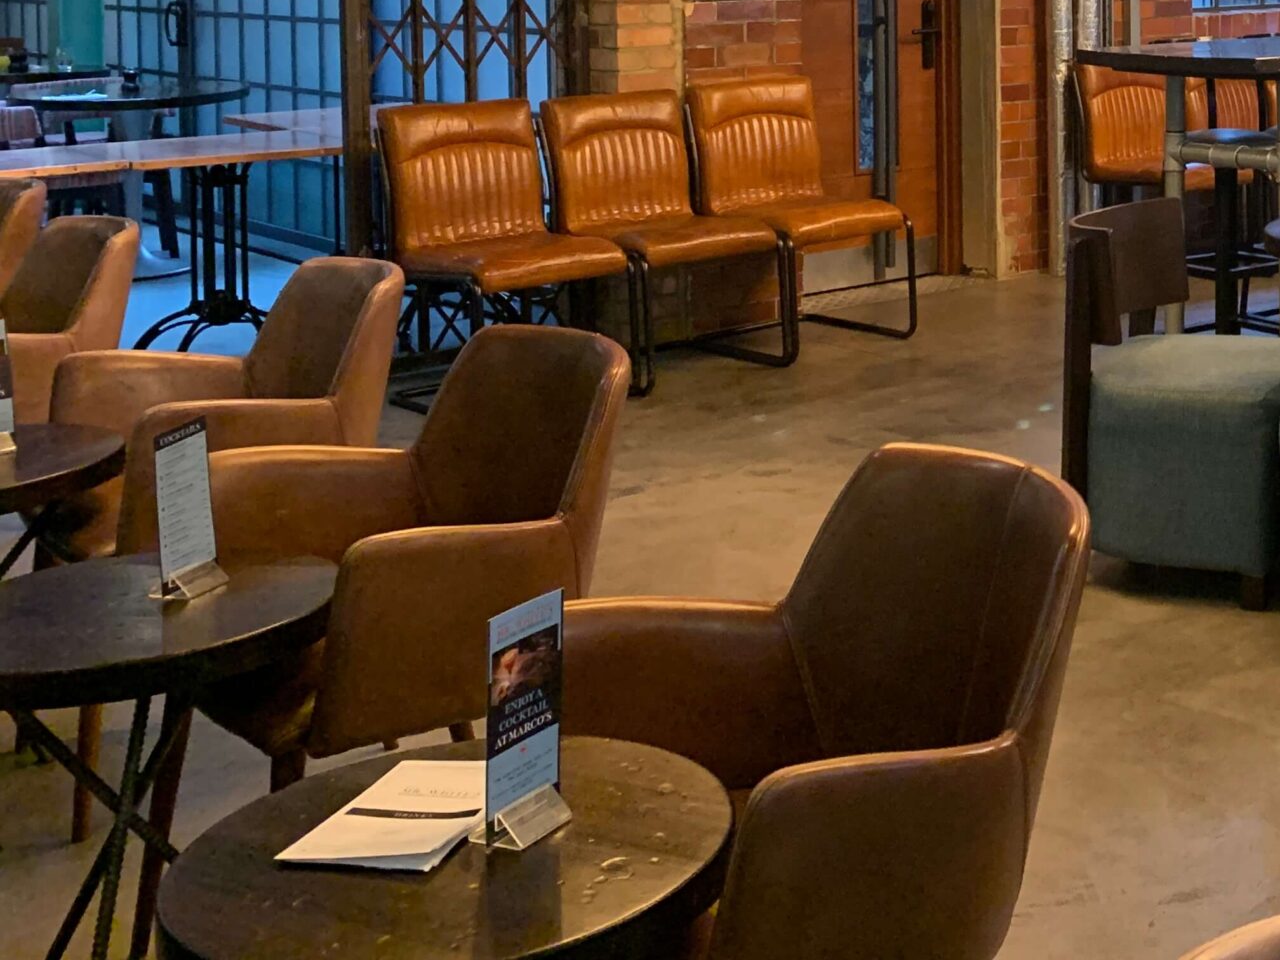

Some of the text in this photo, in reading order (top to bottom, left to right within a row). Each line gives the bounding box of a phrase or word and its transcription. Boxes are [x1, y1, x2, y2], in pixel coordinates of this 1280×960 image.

[160, 422, 201, 446] COCKTAILS
[499, 699, 550, 732] COCKTAIL
[505, 688, 543, 715] ENJOY A
[495, 710, 552, 750] AT MARCO'S
